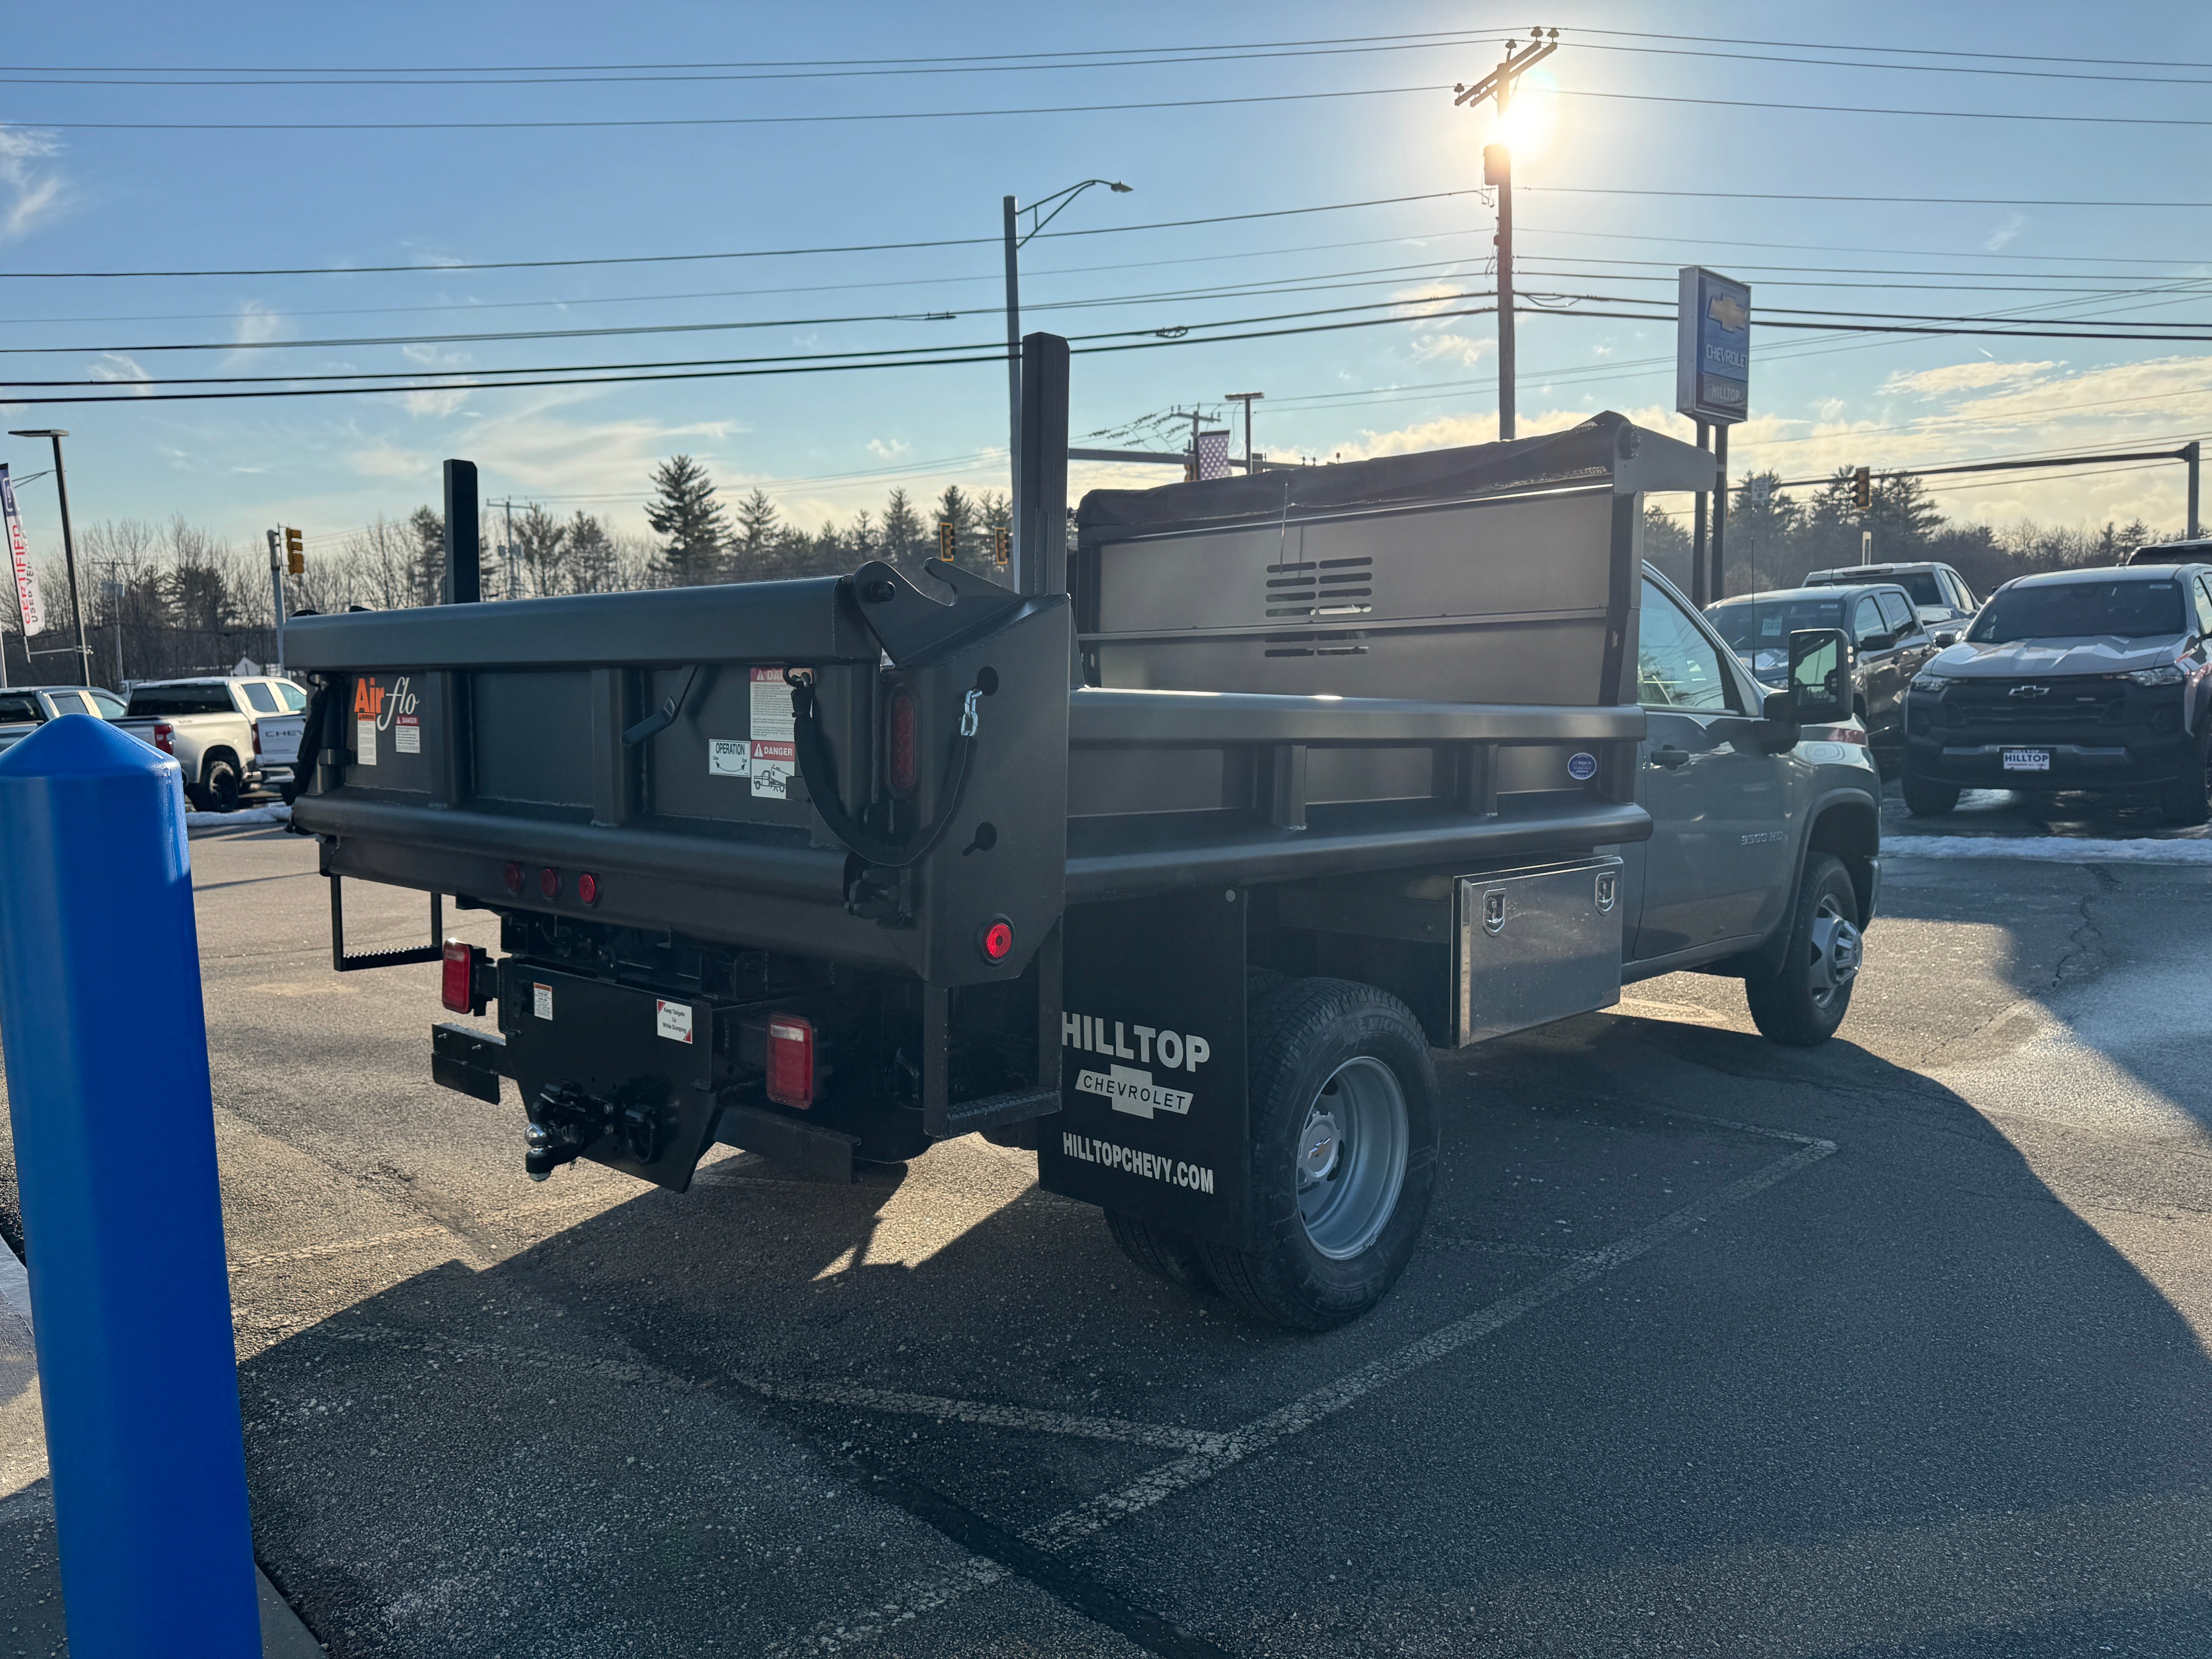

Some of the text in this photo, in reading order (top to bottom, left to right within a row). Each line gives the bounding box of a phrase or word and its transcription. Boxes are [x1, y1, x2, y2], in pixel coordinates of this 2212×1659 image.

[1705, 344, 1748, 368] CHEVROLET
[1712, 384, 1740, 402] HILLTOP
[28, 591, 38, 622] USED
[716, 742, 745, 755] OPERATION
[764, 746, 792, 757] DANGER
[2005, 754, 2048, 763] HILLTOP
[1741, 831, 1784, 845] 3500 HD
[672, 1009, 685, 1017] Tailgate
[672, 1024, 687, 1034] Dumping
[1062, 1011, 1210, 1073] HILLTOP
[1083, 1075, 1186, 1110] CHEVROLET
[1063, 1132, 1214, 1195] HILLTOPCHEVY.COM
